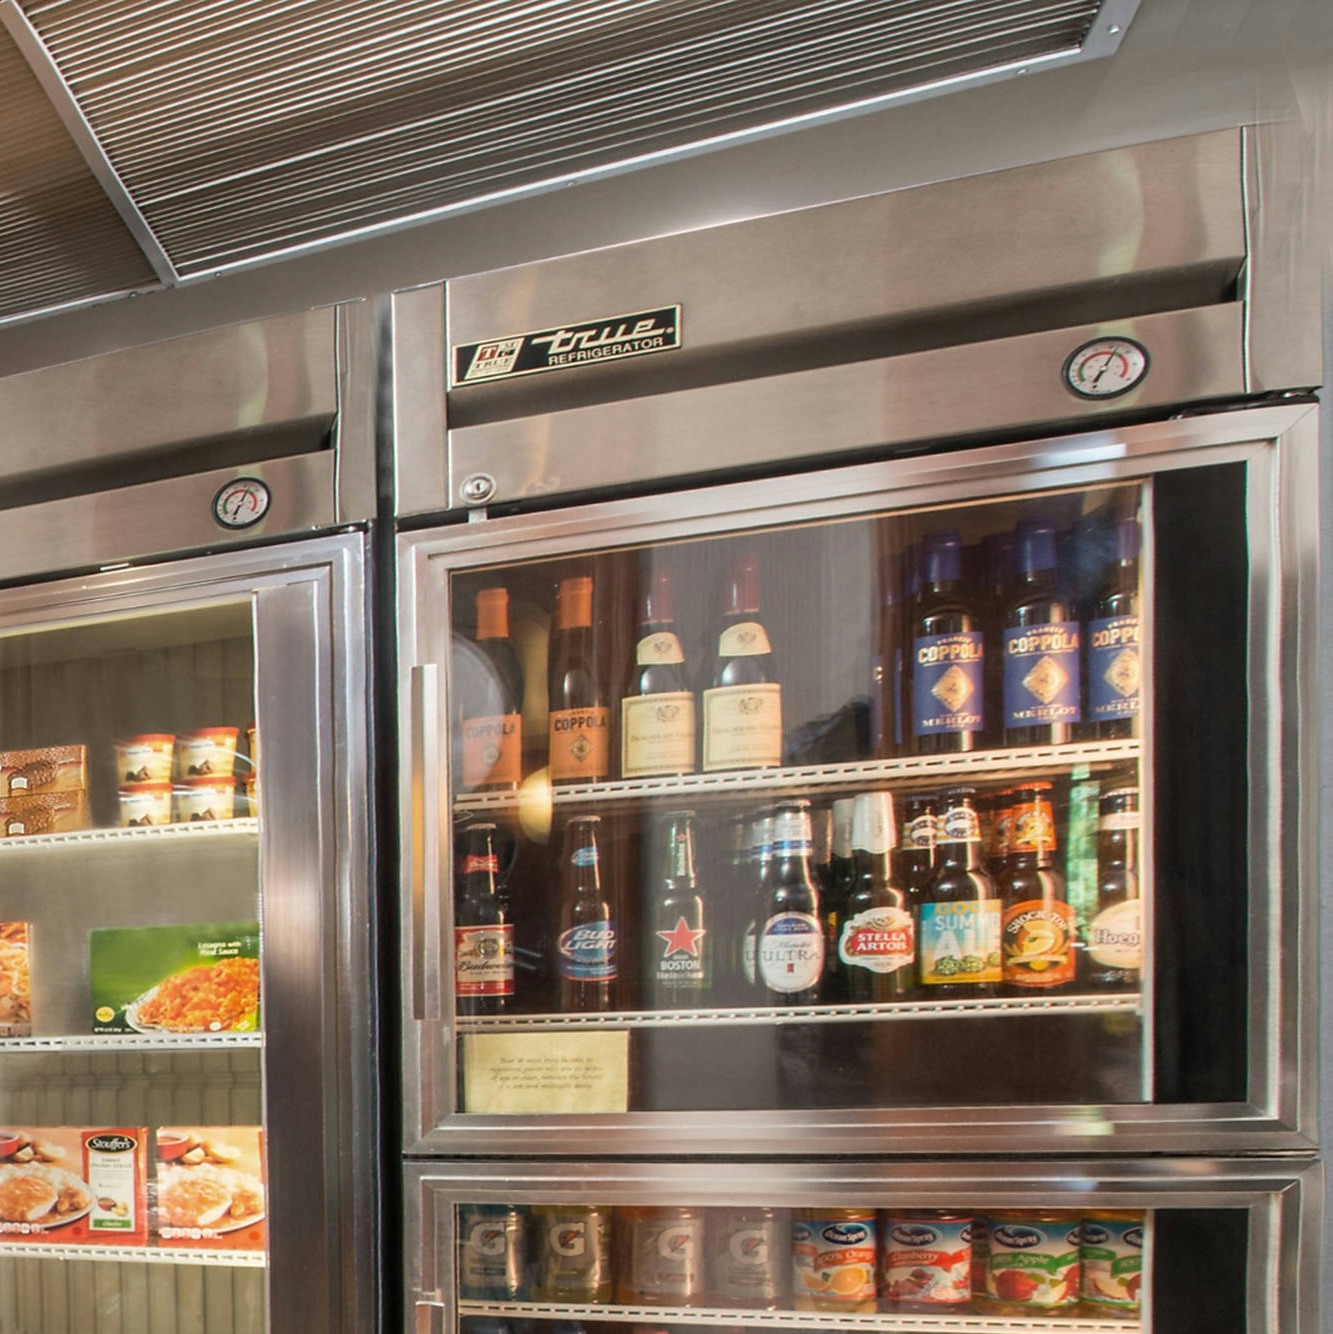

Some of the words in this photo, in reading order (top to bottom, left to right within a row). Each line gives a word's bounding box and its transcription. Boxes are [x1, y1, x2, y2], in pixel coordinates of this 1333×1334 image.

[532, 318, 666, 355] true
[548, 336, 664, 366] REFRIGERATOR
[1007, 632, 1080, 654] COPPOLA
[917, 642, 983, 664] COPPOLA
[1012, 706, 1077, 720] MERLOT
[554, 716, 606, 732] COPPOLA
[573, 930, 614, 940] BUD
[857, 931, 907, 942] STELLA
[564, 939, 617, 950] LIGHT
[856, 941, 907, 951] ARTOIS
[218, 948, 239, 956] Sauce
[762, 950, 820, 962] ULTRA
[660, 960, 701, 971] BOSTON
[91, 1137, 131, 1151] Stouffer's
[470, 1222, 506, 1257] G
[549, 1222, 586, 1258] G
[657, 1226, 695, 1263] G
[729, 1229, 769, 1265] G
[1016, 1254, 1051, 1266] Apple
